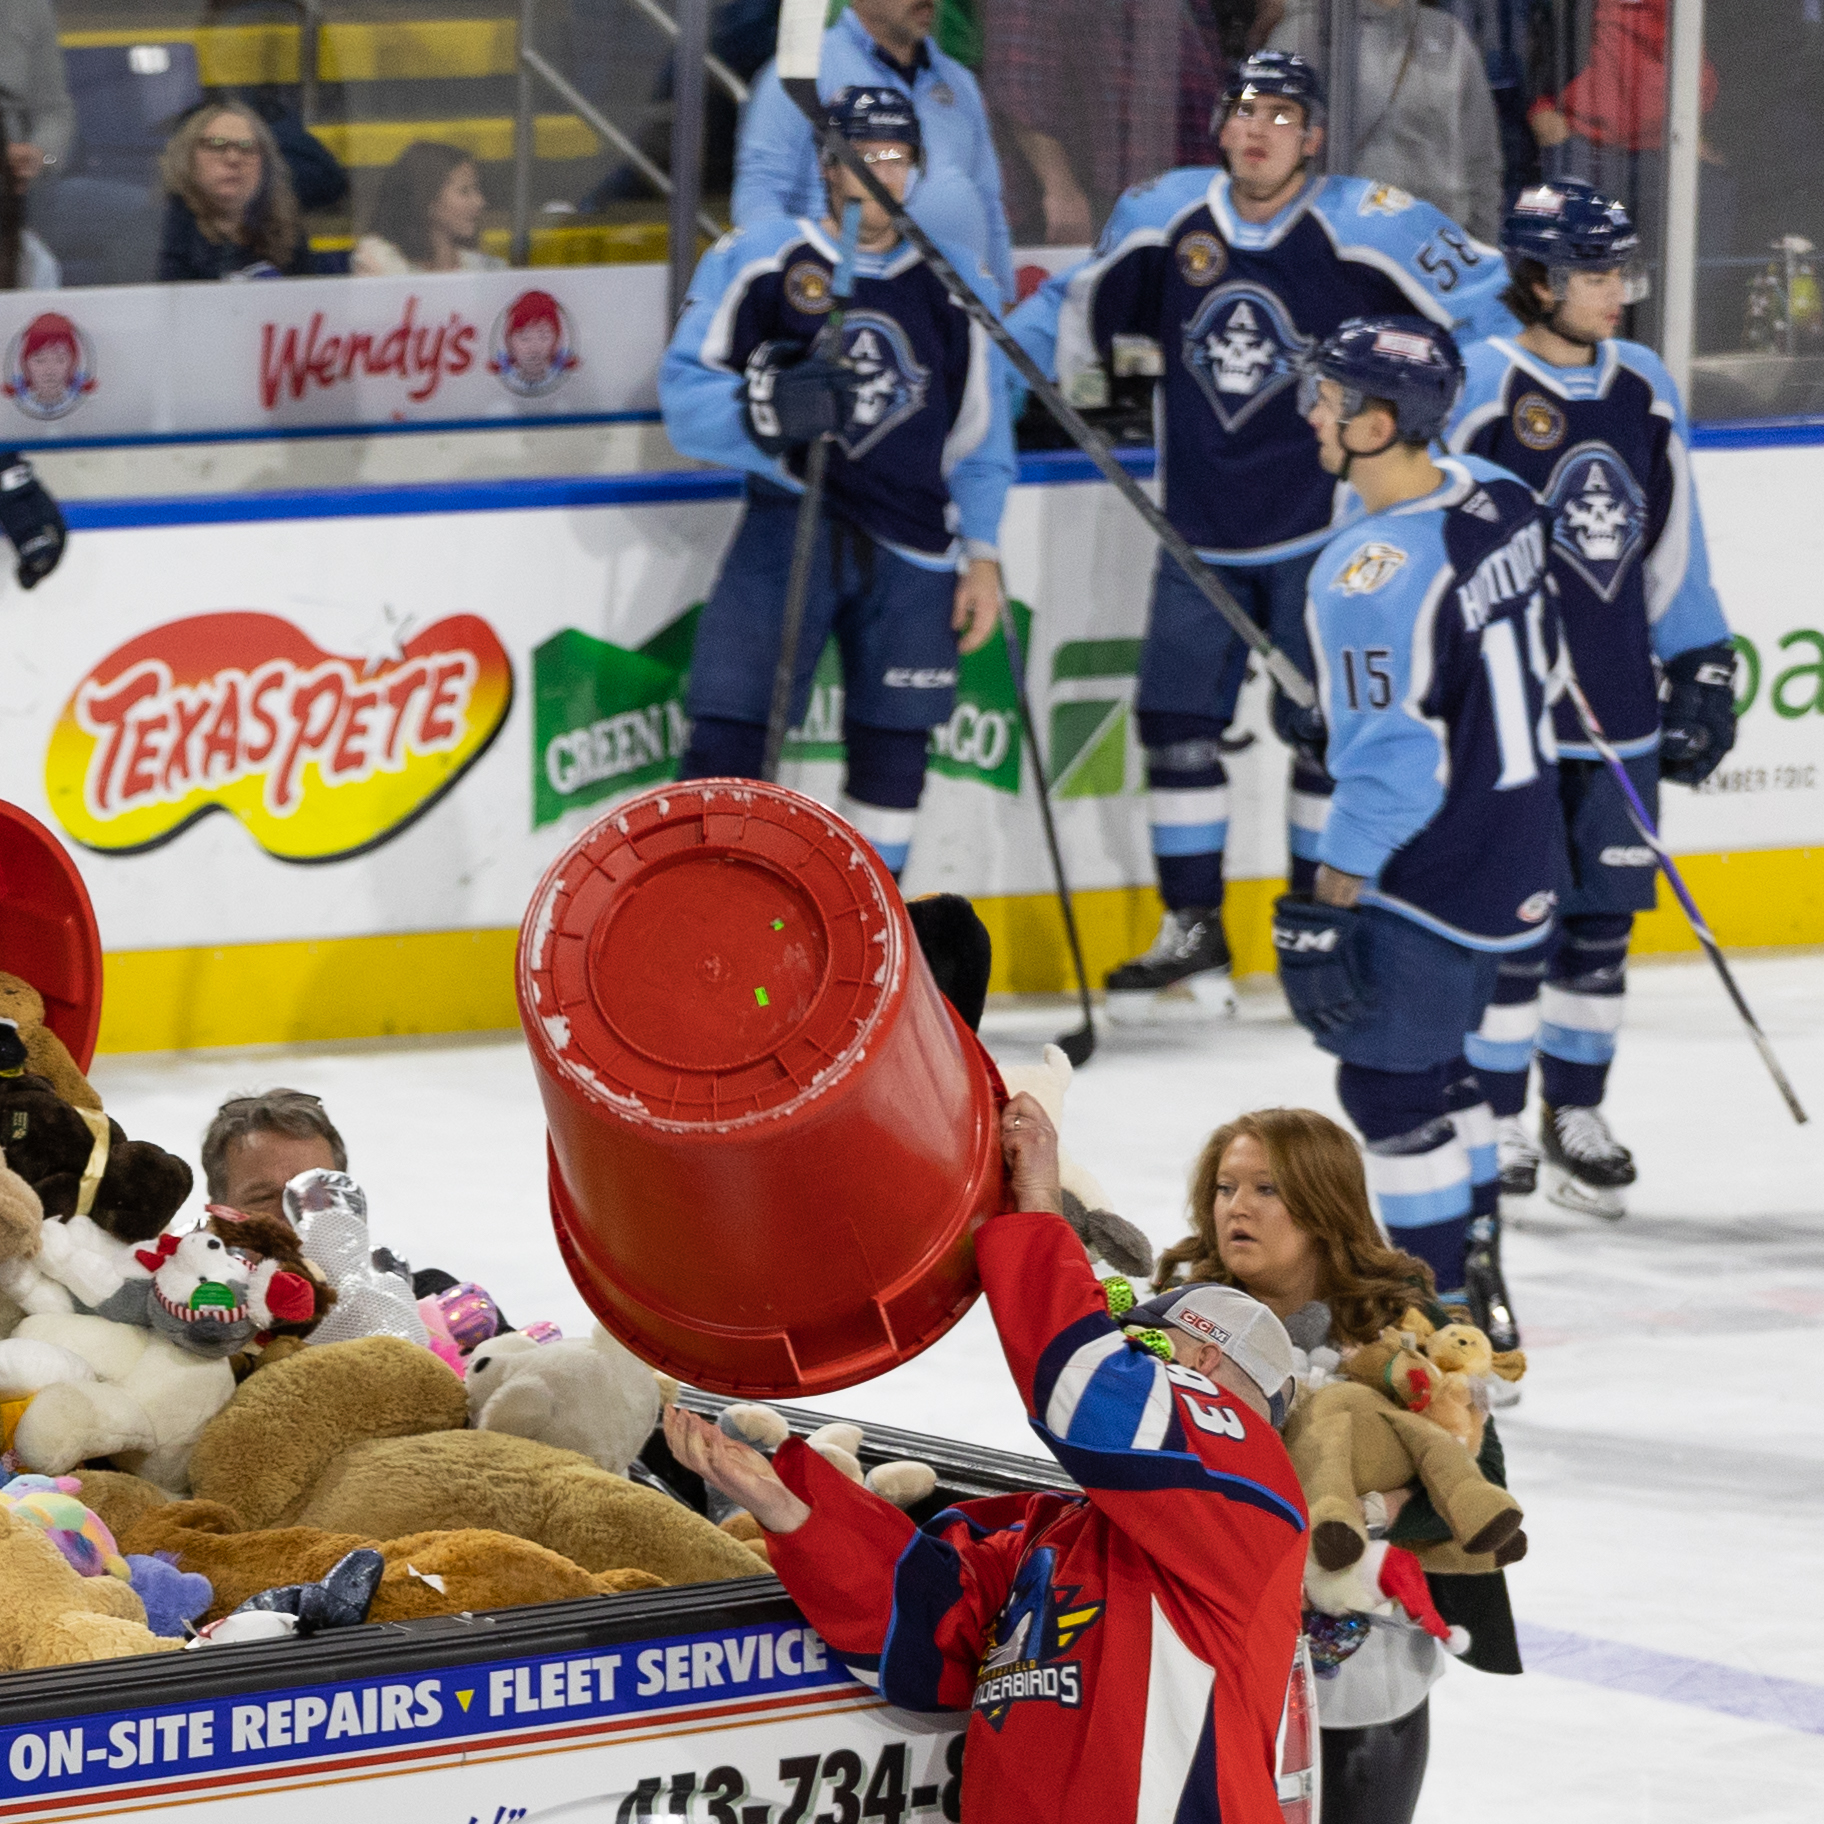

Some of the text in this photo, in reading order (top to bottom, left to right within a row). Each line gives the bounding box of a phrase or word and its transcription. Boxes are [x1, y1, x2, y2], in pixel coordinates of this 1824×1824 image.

[257, 296, 481, 410] Wendy's
[1341, 648, 1394, 712] 15
[79, 653, 472, 816] TEXAS PETE
[544, 705, 664, 796] GREEN
[1181, 1310, 1230, 1346] CCM
[1166, 1362, 1247, 1442] 93
[6, 1708, 216, 1783] ON-SITE
[228, 1678, 444, 1755] REPAIRS
[486, 1652, 623, 1718] FLEET
[634, 1624, 829, 1697] SERVICE
